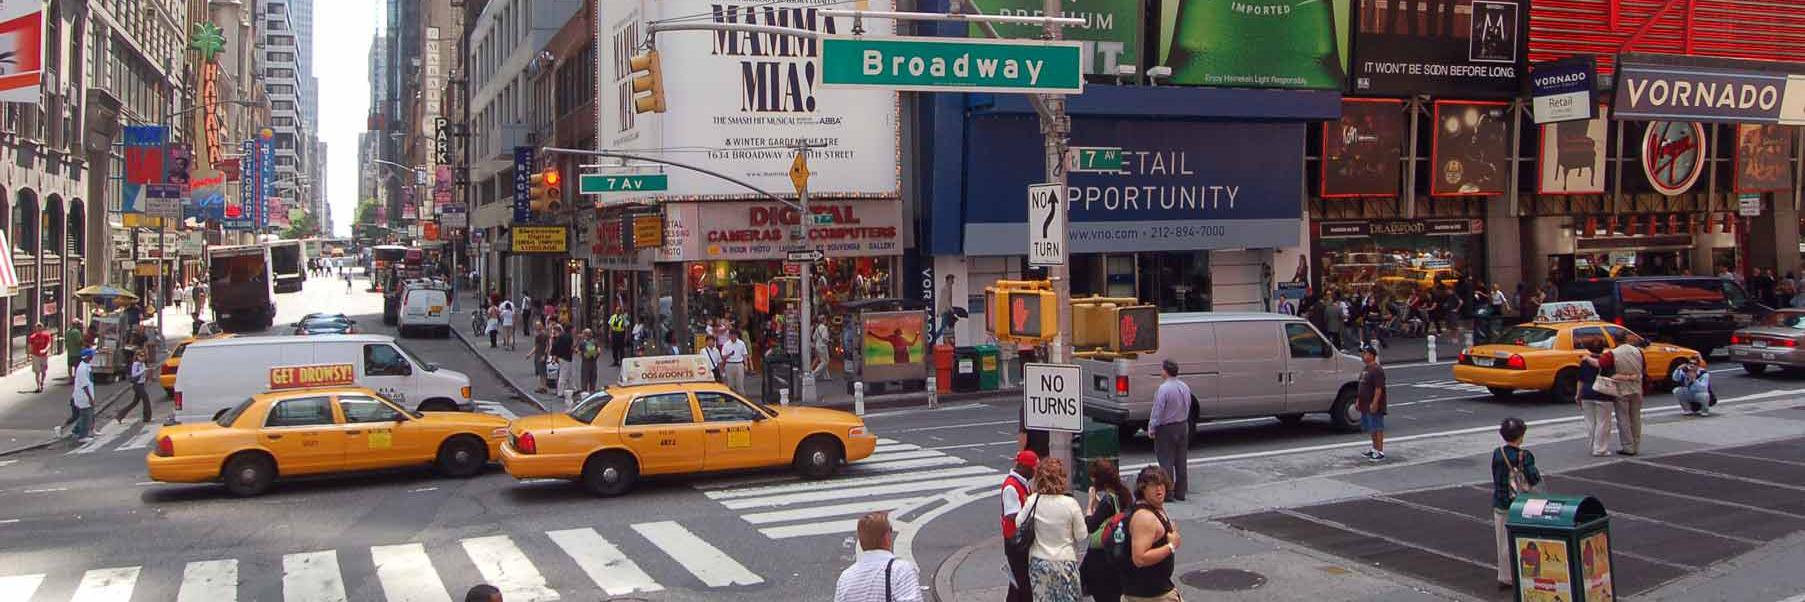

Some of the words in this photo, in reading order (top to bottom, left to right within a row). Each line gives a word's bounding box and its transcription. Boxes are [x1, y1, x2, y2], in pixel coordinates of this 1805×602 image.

[1232, 2, 1290, 15] IMPORTED
[999, 8, 1113, 30] PREIUM
[862, 49, 1044, 85] Broadway
[1364, 62, 1374, 73] IT
[1375, 62, 1407, 75] WON'T
[1408, 64, 1422, 75] BE
[1423, 64, 1448, 76] SOON
[1450, 66, 1487, 77] BEFORE
[1488, 67, 1516, 78] LONG.
[741, 61, 816, 112] MIA!
[1535, 72, 1586, 87] VORNADO
[1549, 96, 1573, 108] Retail
[1627, 78, 1777, 110] VORNADO
[204, 63, 225, 164] HAVANA
[713, 117, 725, 125] THE
[436, 119, 448, 163] PARK
[733, 138, 765, 146] WINTER
[768, 138, 800, 146] GARDEN
[732, 151, 783, 159] BROADWAY
[824, 151, 854, 159] STREET
[1086, 150, 1097, 168] 7
[1104, 151, 1116, 160] AV
[1098, 151, 1194, 175] ETAIL
[607, 178, 614, 189] 7
[622, 178, 643, 189] Av
[1032, 191, 1047, 209] NO
[1067, 186, 1239, 211] PPORTUNITY
[750, 205, 860, 226] DIGTAL
[708, 228, 783, 242] CAMERAS
[809, 226, 897, 240] COMPUTERS
[1069, 227, 1138, 241] ww.vno.com
[1151, 226, 1225, 239] 212-894-7000
[1034, 242, 1060, 258] TURN
[272, 368, 294, 384] GET
[300, 365, 352, 382] DROWSY!
[1041, 374, 1064, 393] NO
[1030, 397, 1077, 416] TURNS
